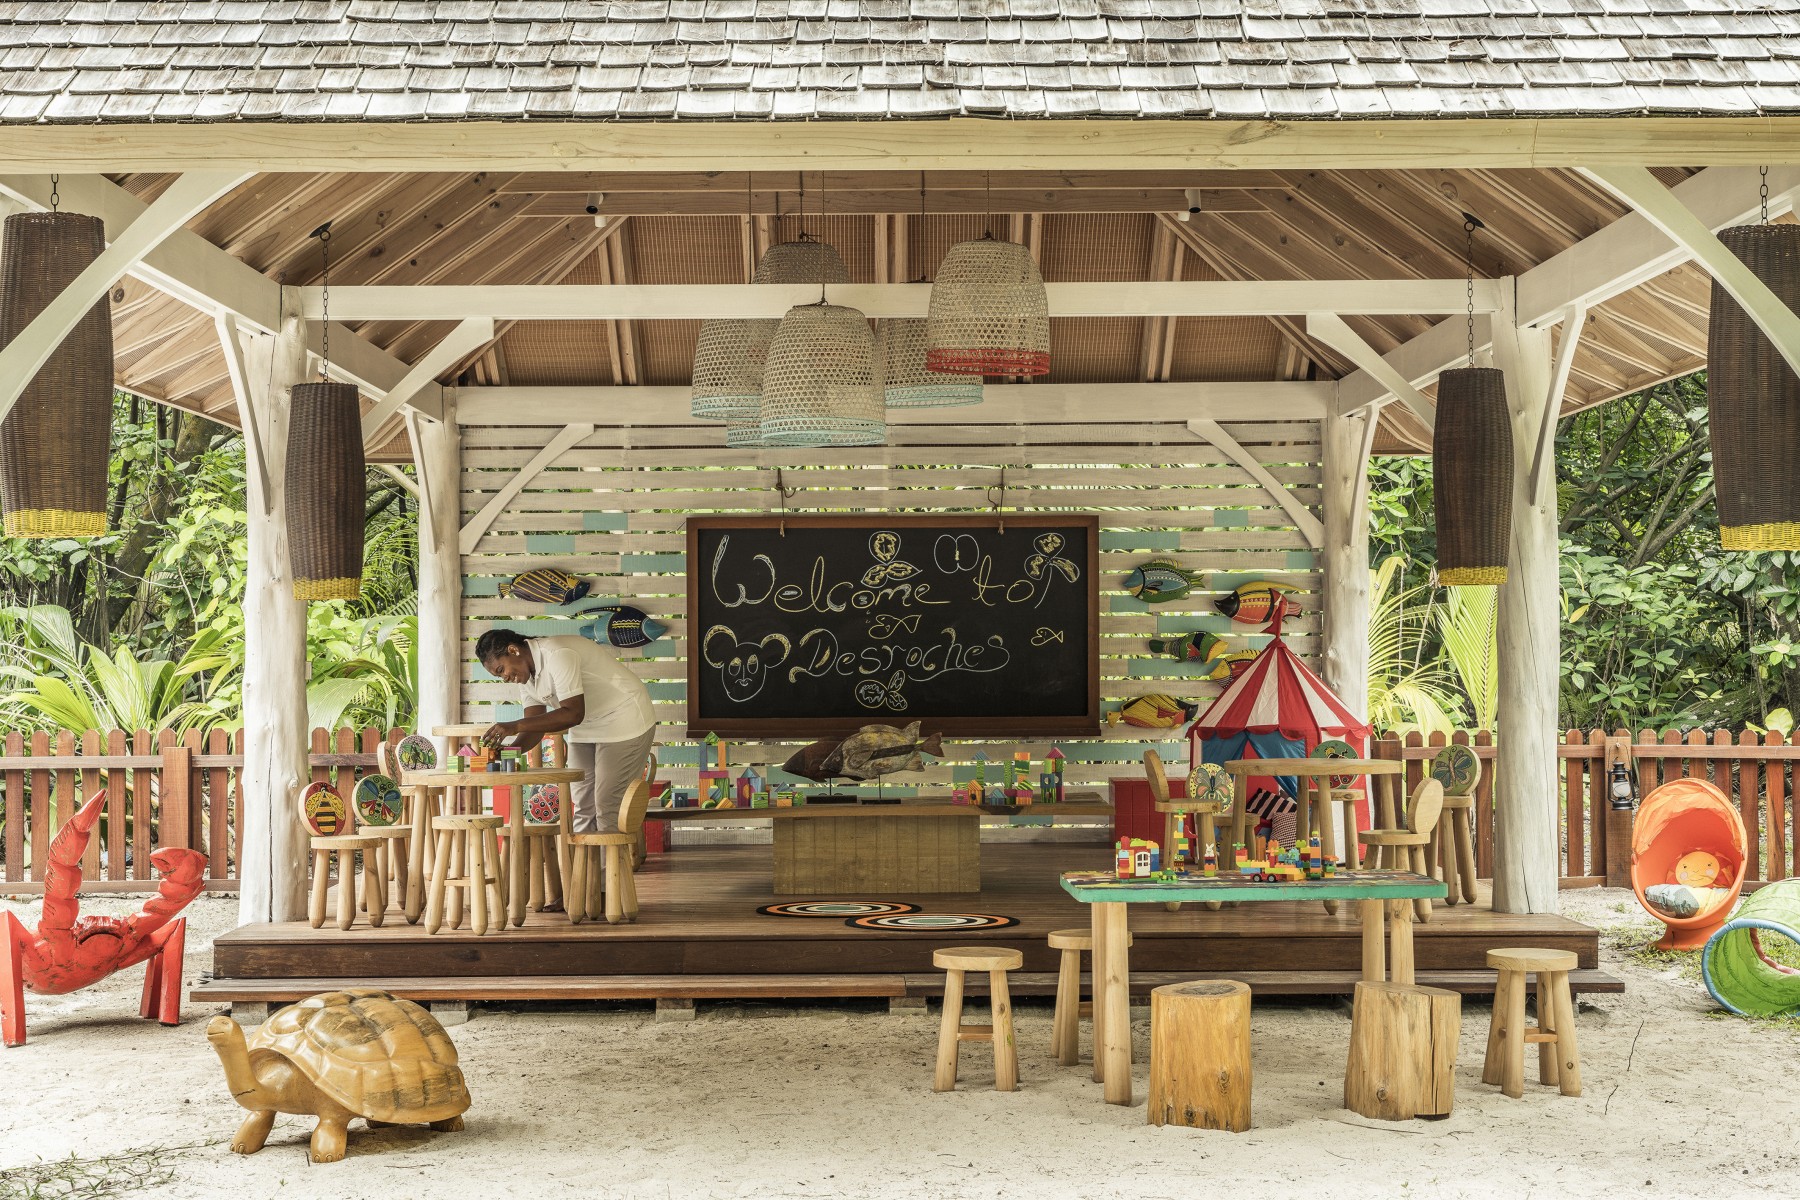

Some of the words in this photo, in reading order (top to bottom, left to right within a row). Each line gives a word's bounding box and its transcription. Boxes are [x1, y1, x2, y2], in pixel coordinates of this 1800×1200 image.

[712, 533, 951, 613] Welcome
[971, 555, 1035, 606] to
[789, 627, 1010, 682] Desroches
